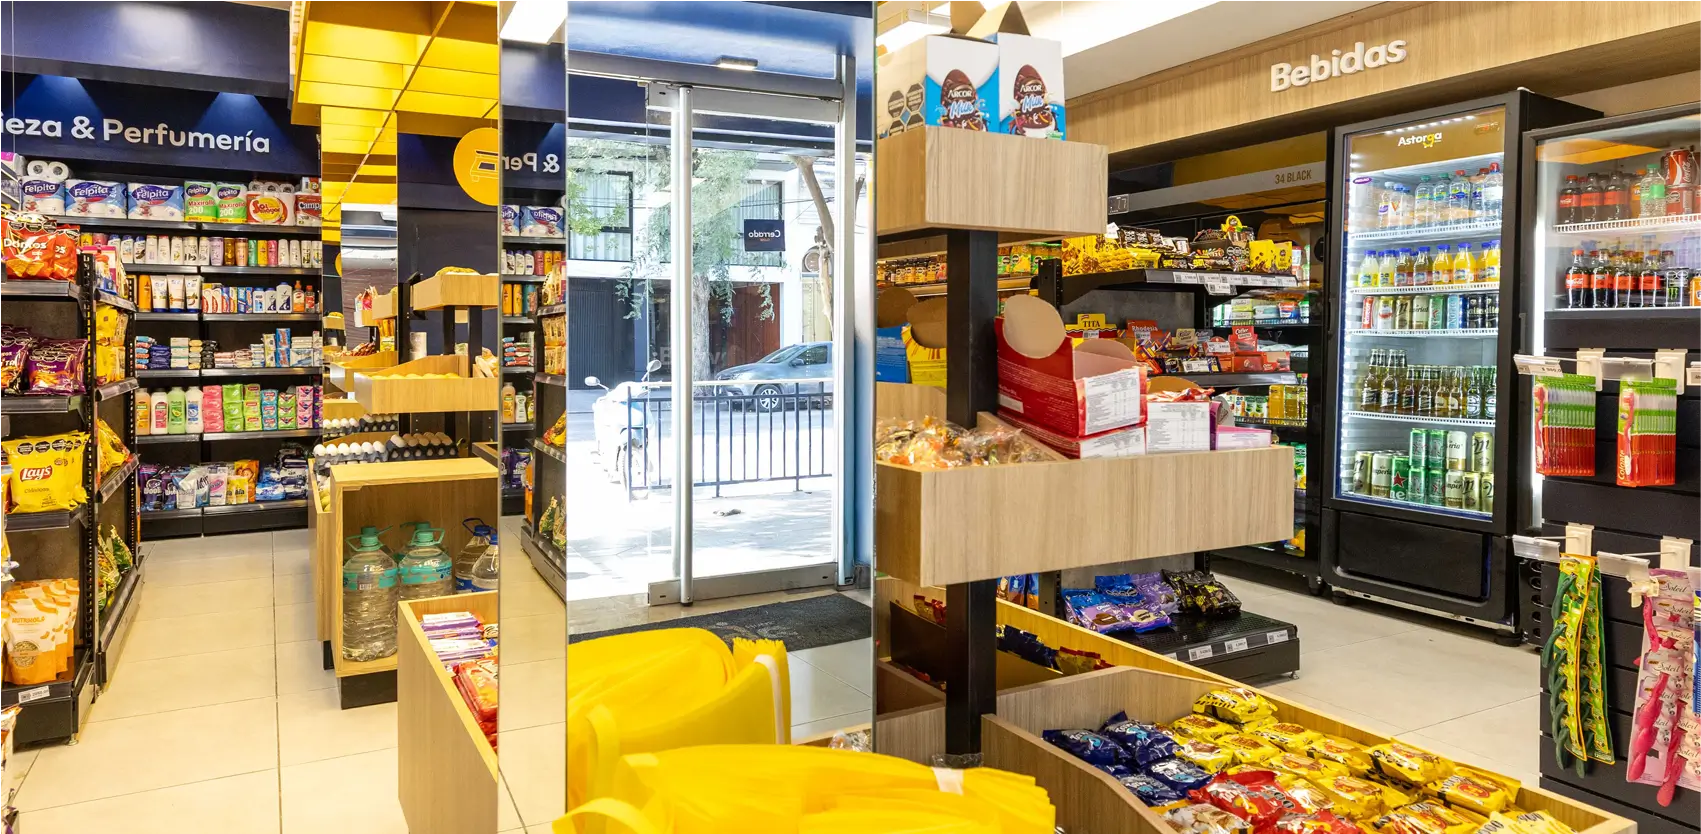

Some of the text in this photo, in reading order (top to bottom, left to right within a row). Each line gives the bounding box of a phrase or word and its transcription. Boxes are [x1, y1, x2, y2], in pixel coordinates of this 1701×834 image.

[1271, 39, 1407, 92] Bebidas
[948, 89, 973, 98] ARCOR
[1020, 84, 1042, 93] ARCOR
[949, 100, 975, 118] Milk
[1021, 95, 1044, 113] Milk
[71, 116, 95, 139] &
[103, 118, 270, 153] Perfumería
[1398, 132, 1443, 148] Astorga
[1275, 169, 1312, 184] 34 BLACK
[24, 184, 56, 193] Felpita
[74, 185, 108, 198] Felpita
[136, 187, 169, 201] Felpita
[1083, 320, 1101, 328] TITA
[1663, 583, 1688, 592] Soleil
